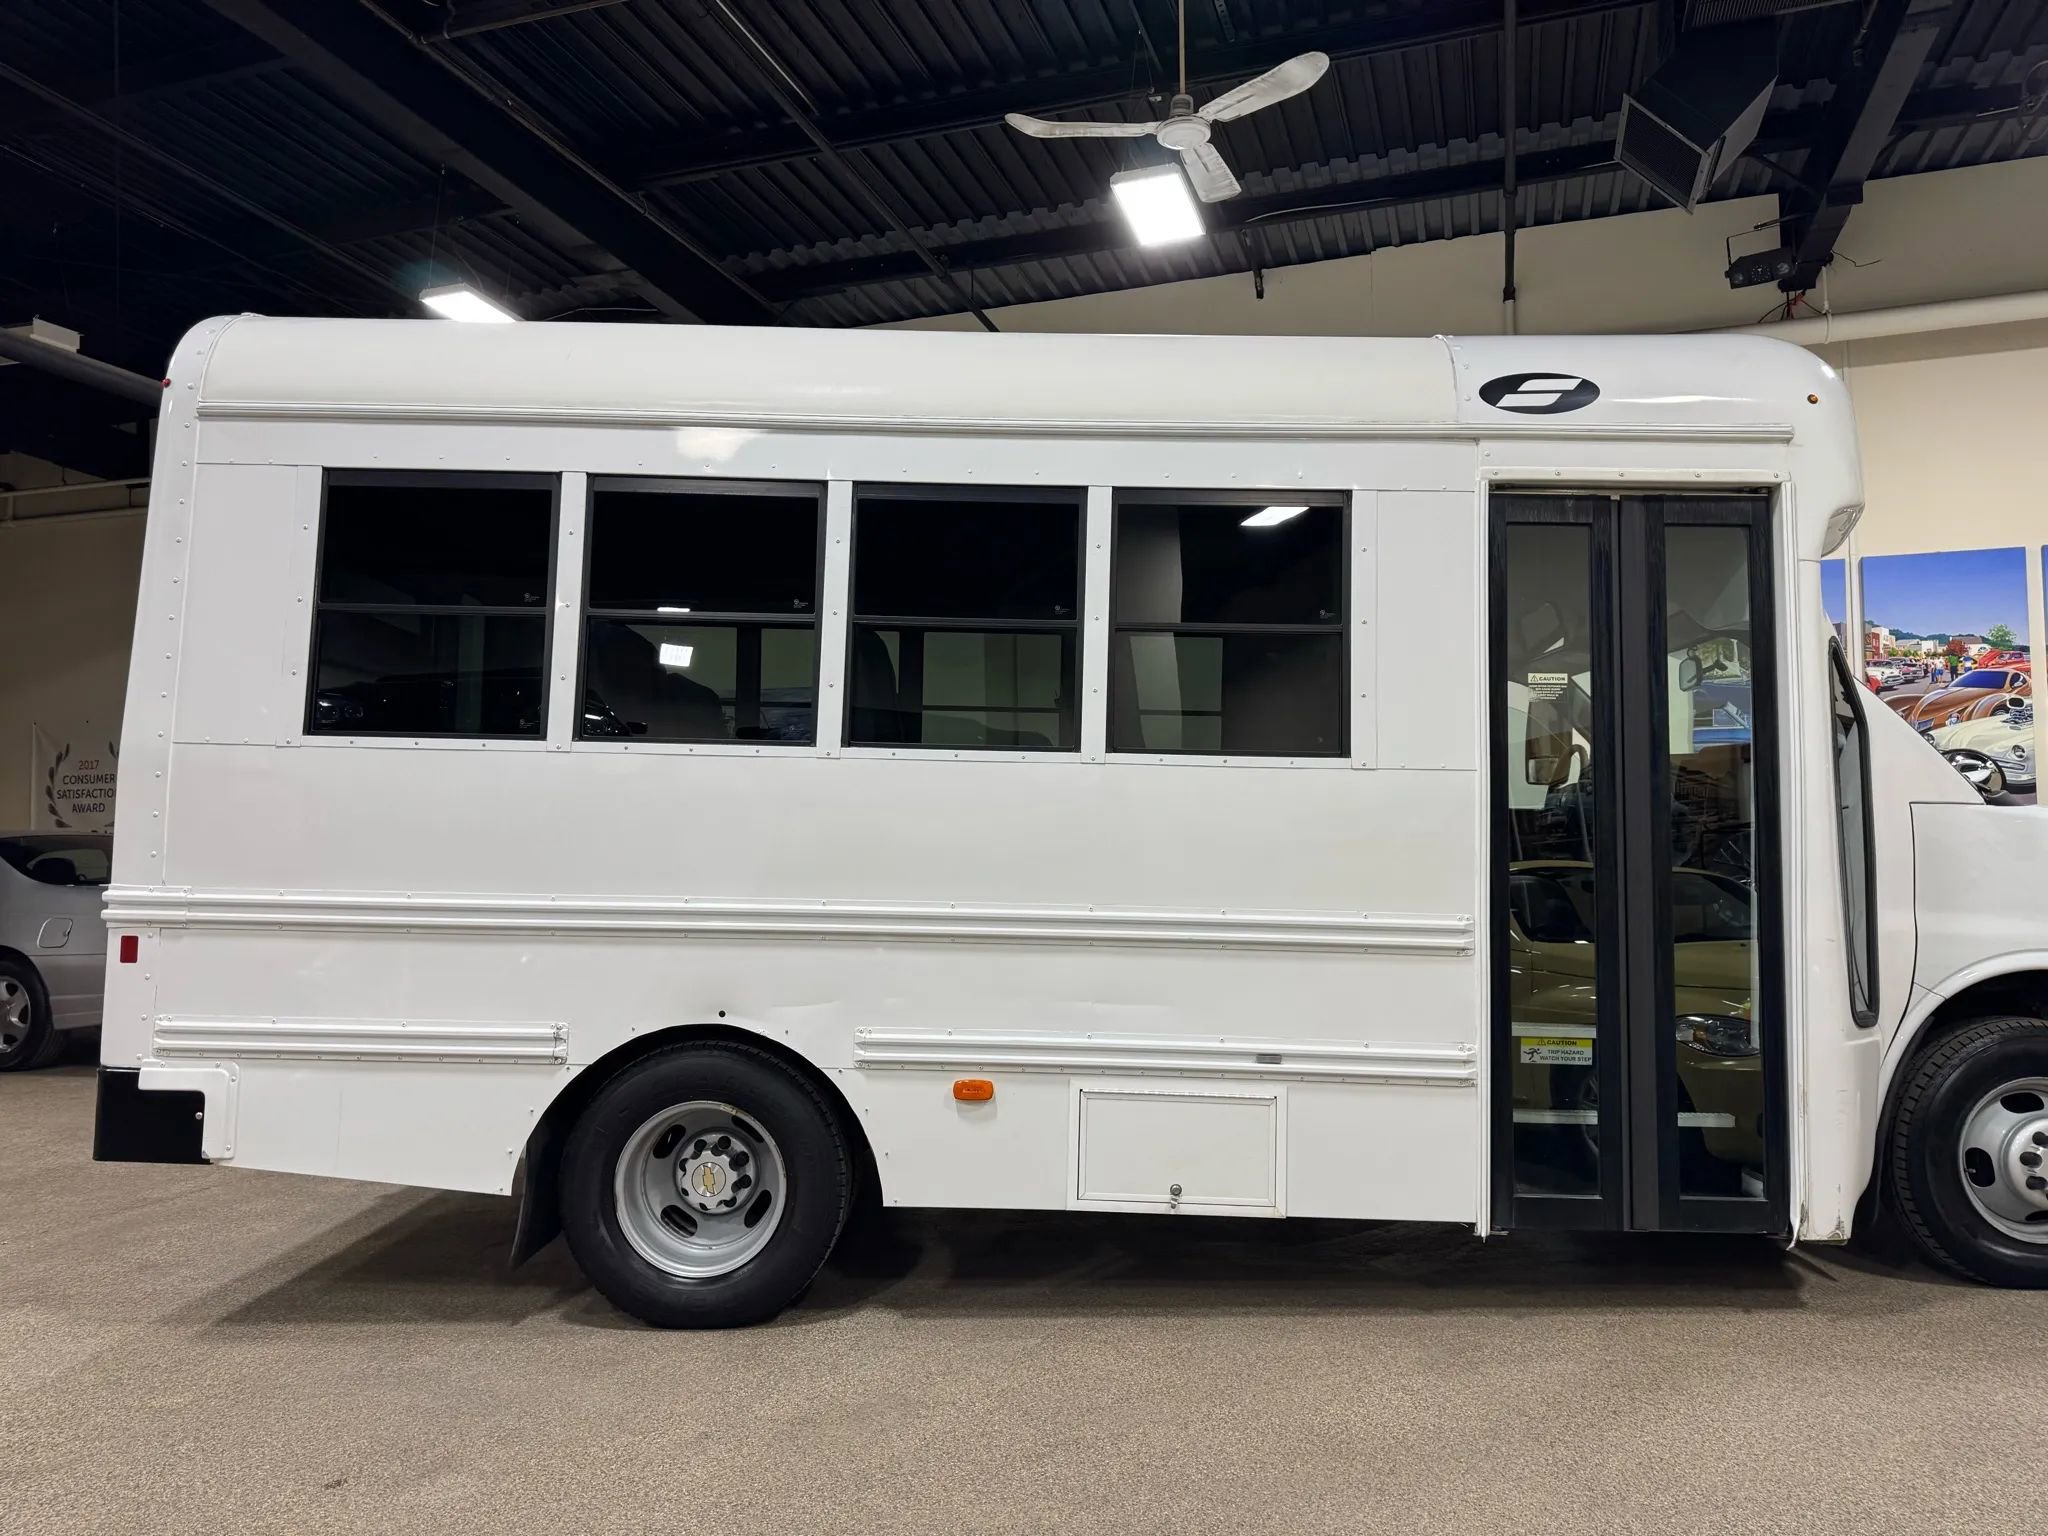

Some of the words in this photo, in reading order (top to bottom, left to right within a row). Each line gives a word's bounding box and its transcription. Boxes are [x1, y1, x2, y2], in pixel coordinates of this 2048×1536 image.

[79, 760, 99, 770] 2017
[62, 773, 115, 785] CONSUMER
[56, 788, 117, 800] SATISFACTIO
[72, 803, 106, 813] AWARD
